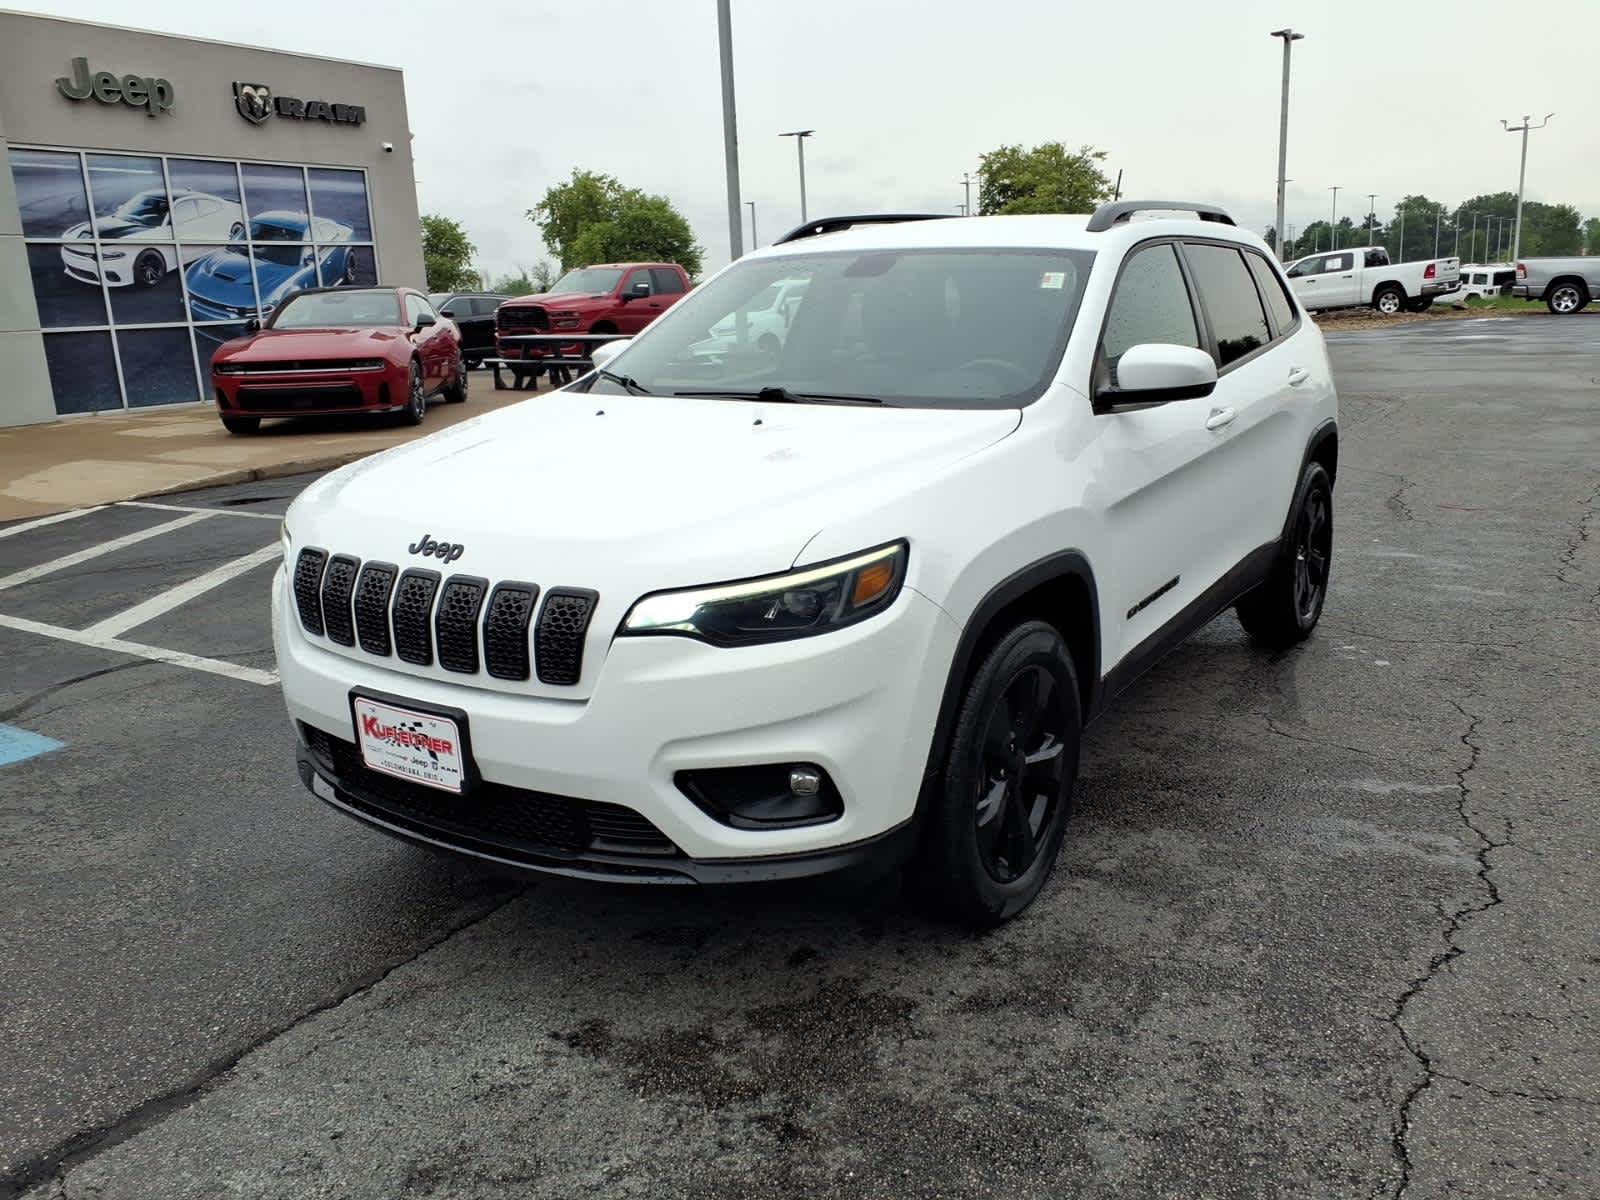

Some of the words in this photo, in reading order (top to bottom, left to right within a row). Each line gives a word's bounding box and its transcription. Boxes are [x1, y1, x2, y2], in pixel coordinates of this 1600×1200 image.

[56, 57, 174, 114] Jeep
[274, 97, 366, 123] RAM
[408, 534, 464, 564] Jeep
